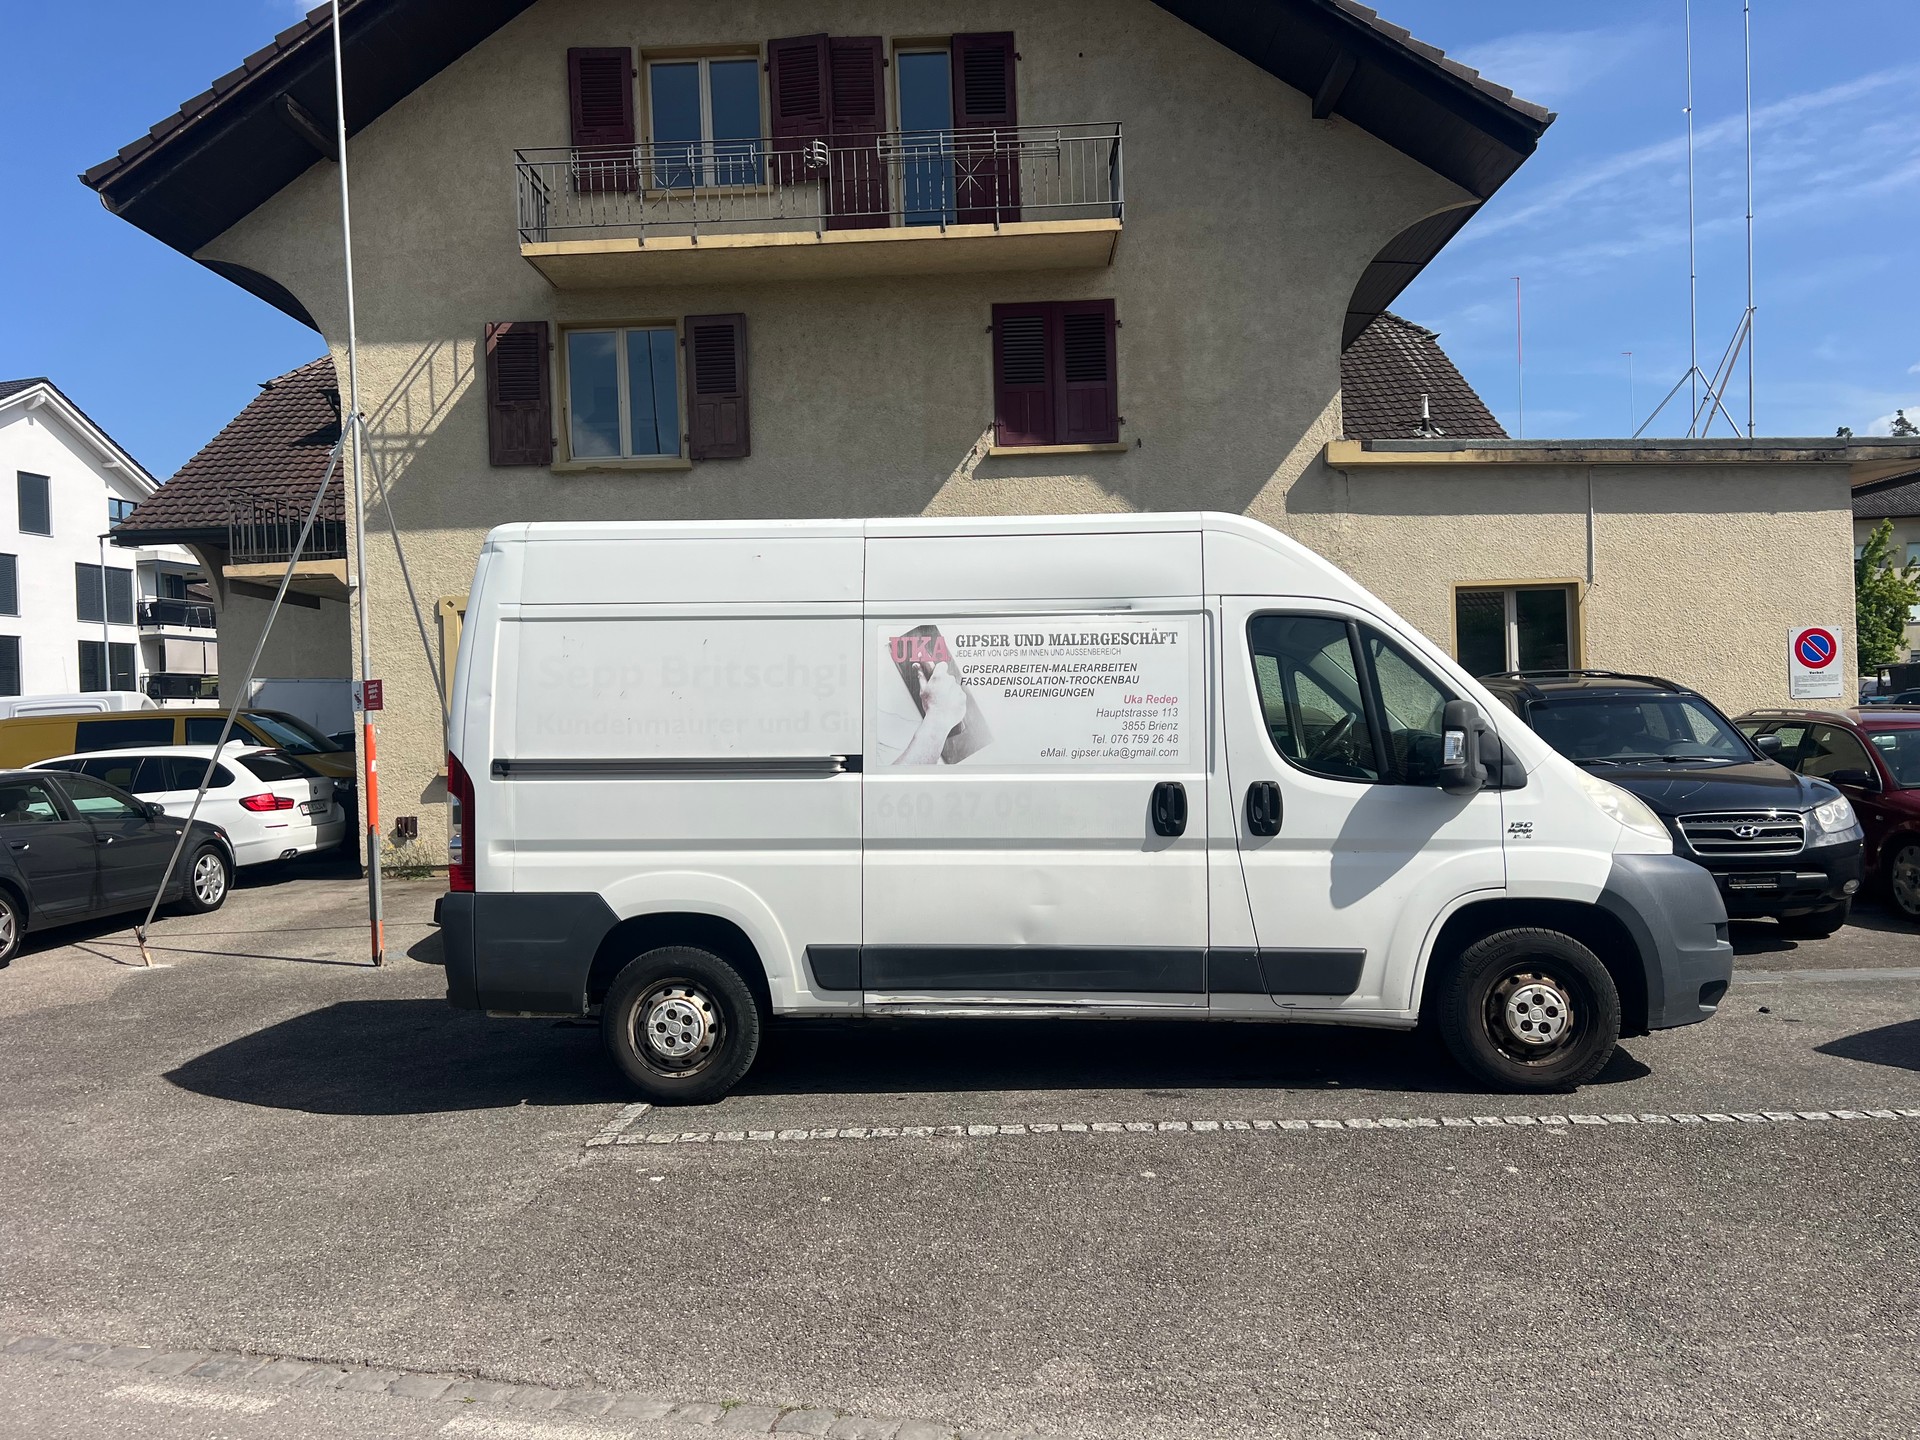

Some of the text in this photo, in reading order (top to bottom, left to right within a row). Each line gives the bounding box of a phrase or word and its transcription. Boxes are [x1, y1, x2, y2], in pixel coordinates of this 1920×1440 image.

[955, 628, 1178, 647] GIPSER UND MALERGESCHÄFT
[889, 636, 951, 663] UKA
[956, 647, 1122, 658] JEDE ART VON GIPS IM INNEN UND AUSSENBEREICH
[962, 663, 1138, 673] GIPSERARBEITEN-MALERARBEITEN
[960, 675, 1140, 686] FASSADENISOLATION-TROCKENBAU
[1004, 688, 1095, 698] BAUREINIGUNGEN
[1123, 694, 1178, 706] Uka Redep
[1095, 707, 1179, 719] Hauptstrasse 113
[1121, 720, 1179, 731] 3855 Brienz
[1091, 734, 1179, 744] Tel. 076 759 26 48
[1040, 746, 1179, 759] eMail. gipser.uka@gmail.com
